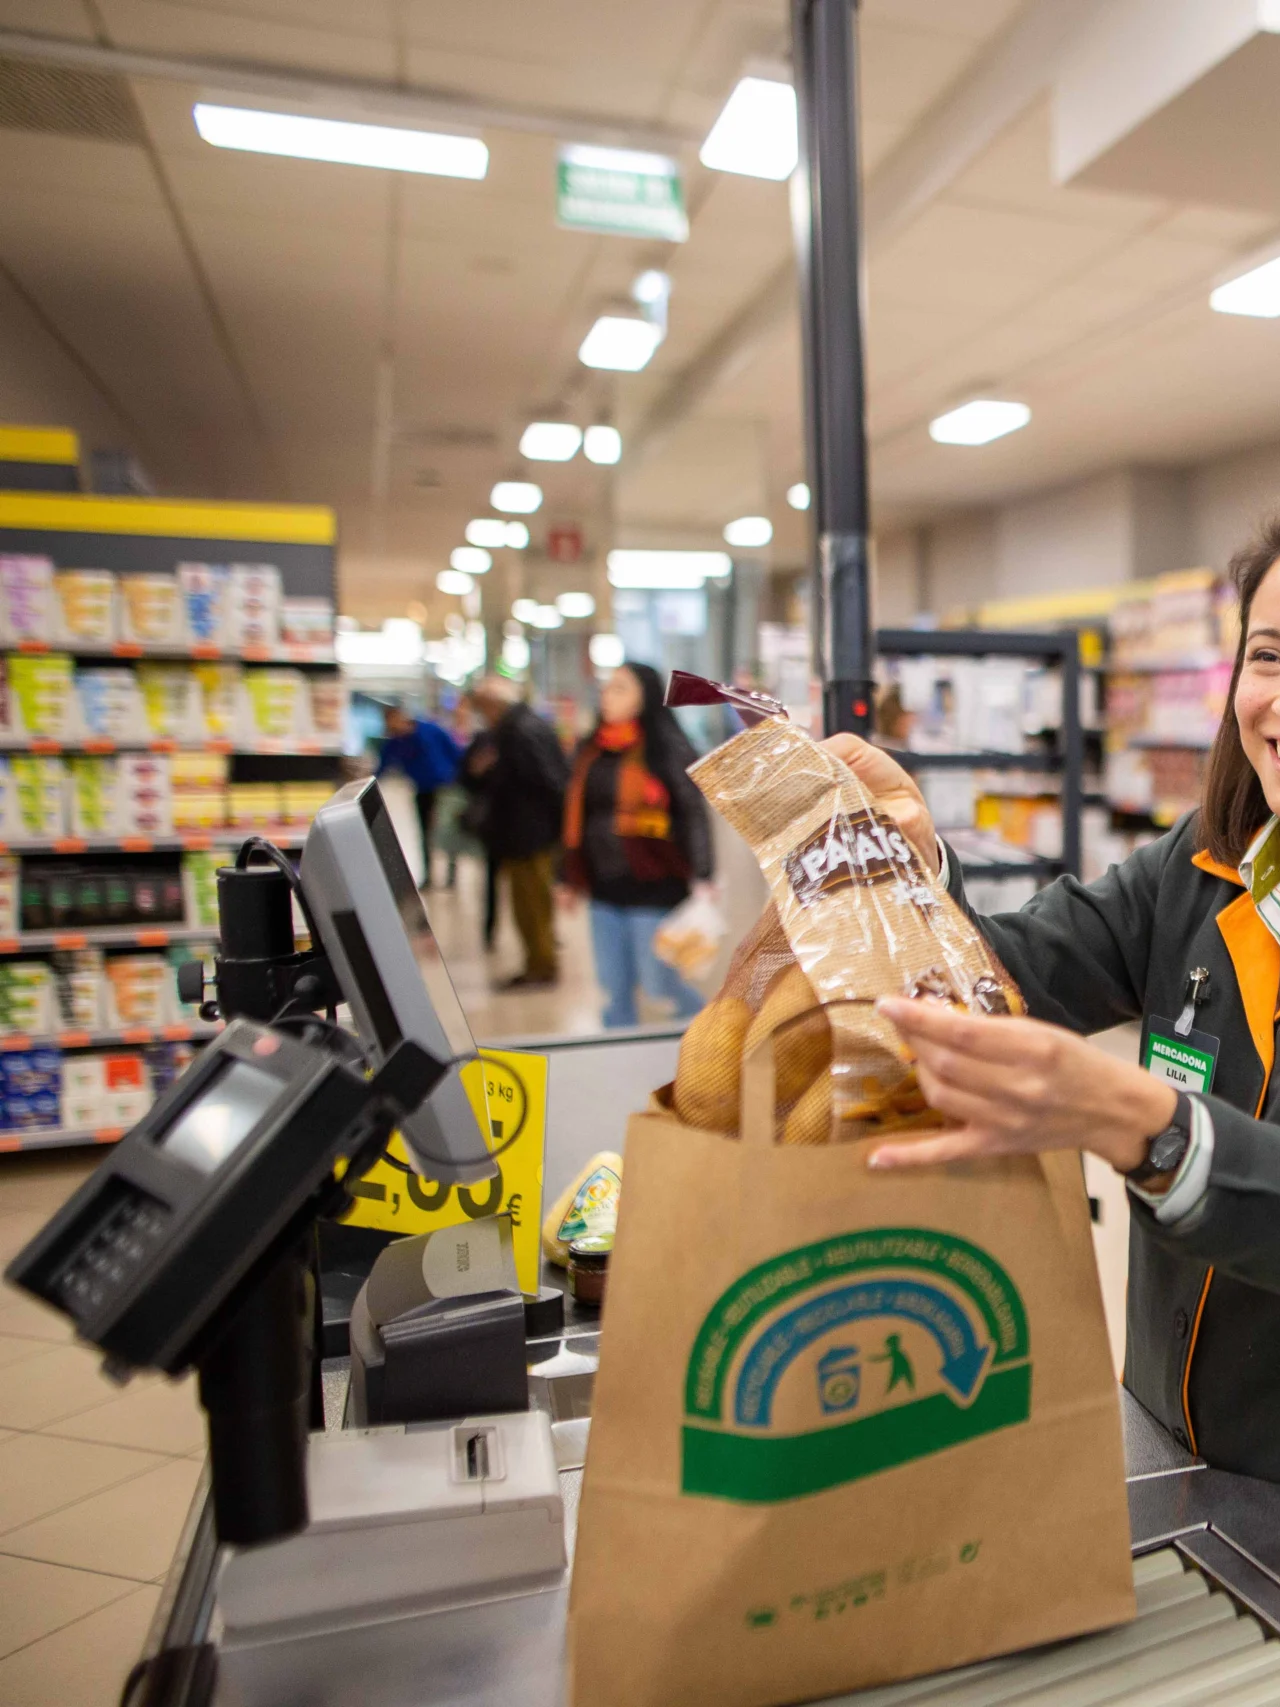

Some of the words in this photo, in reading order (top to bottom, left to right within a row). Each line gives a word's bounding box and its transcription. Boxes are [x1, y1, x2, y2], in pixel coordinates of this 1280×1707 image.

[1152, 1041, 1207, 1072] MERCADONA
[1166, 1067, 1187, 1084] LILIA
[487, 1081, 495, 1096] 3
[498, 1081, 514, 1102] kg
